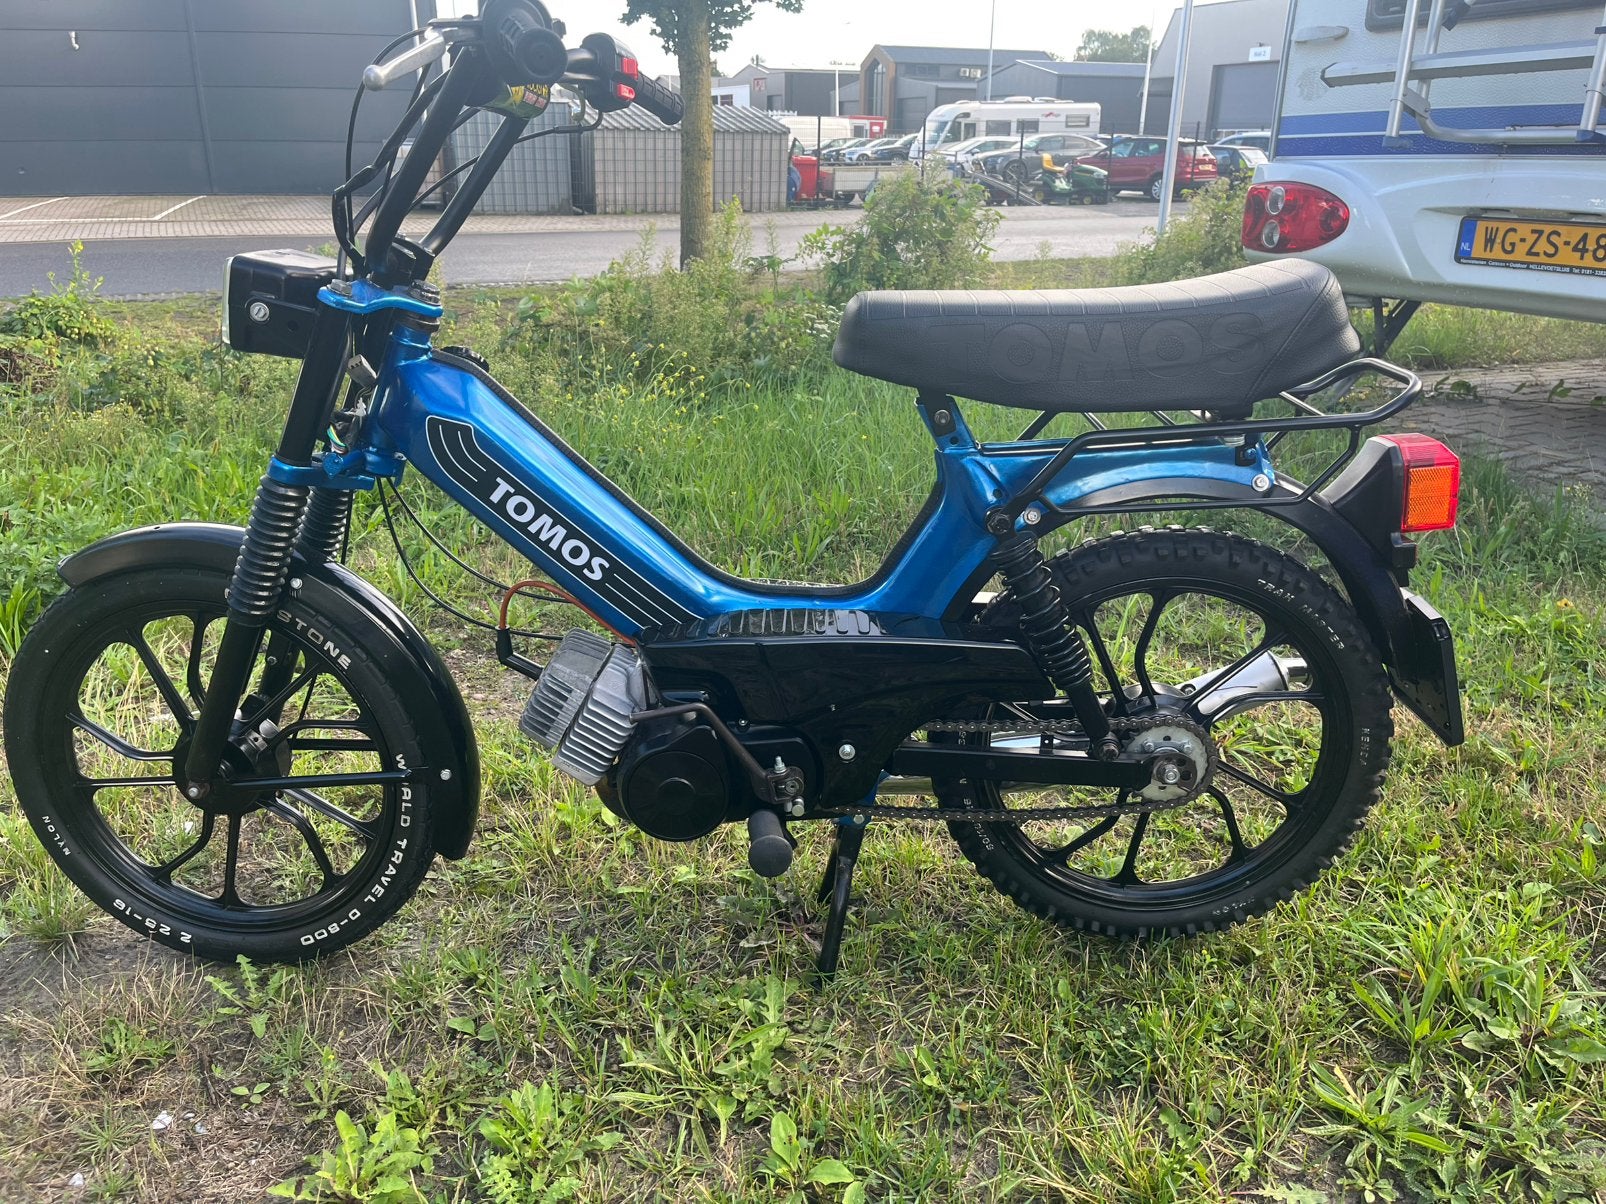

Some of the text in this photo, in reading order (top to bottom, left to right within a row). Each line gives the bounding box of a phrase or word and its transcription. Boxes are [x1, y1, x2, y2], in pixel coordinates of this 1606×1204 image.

[1460, 242, 1471, 251] NL
[1483, 226, 1606, 263] WG-ZS-48
[928, 312, 1266, 386] TOMOS
[489, 477, 610, 580] TOMOS
[277, 609, 352, 670] STONE
[41, 815, 71, 856] NYLON
[300, 753, 412, 946] WRLD TRAVEL D-800
